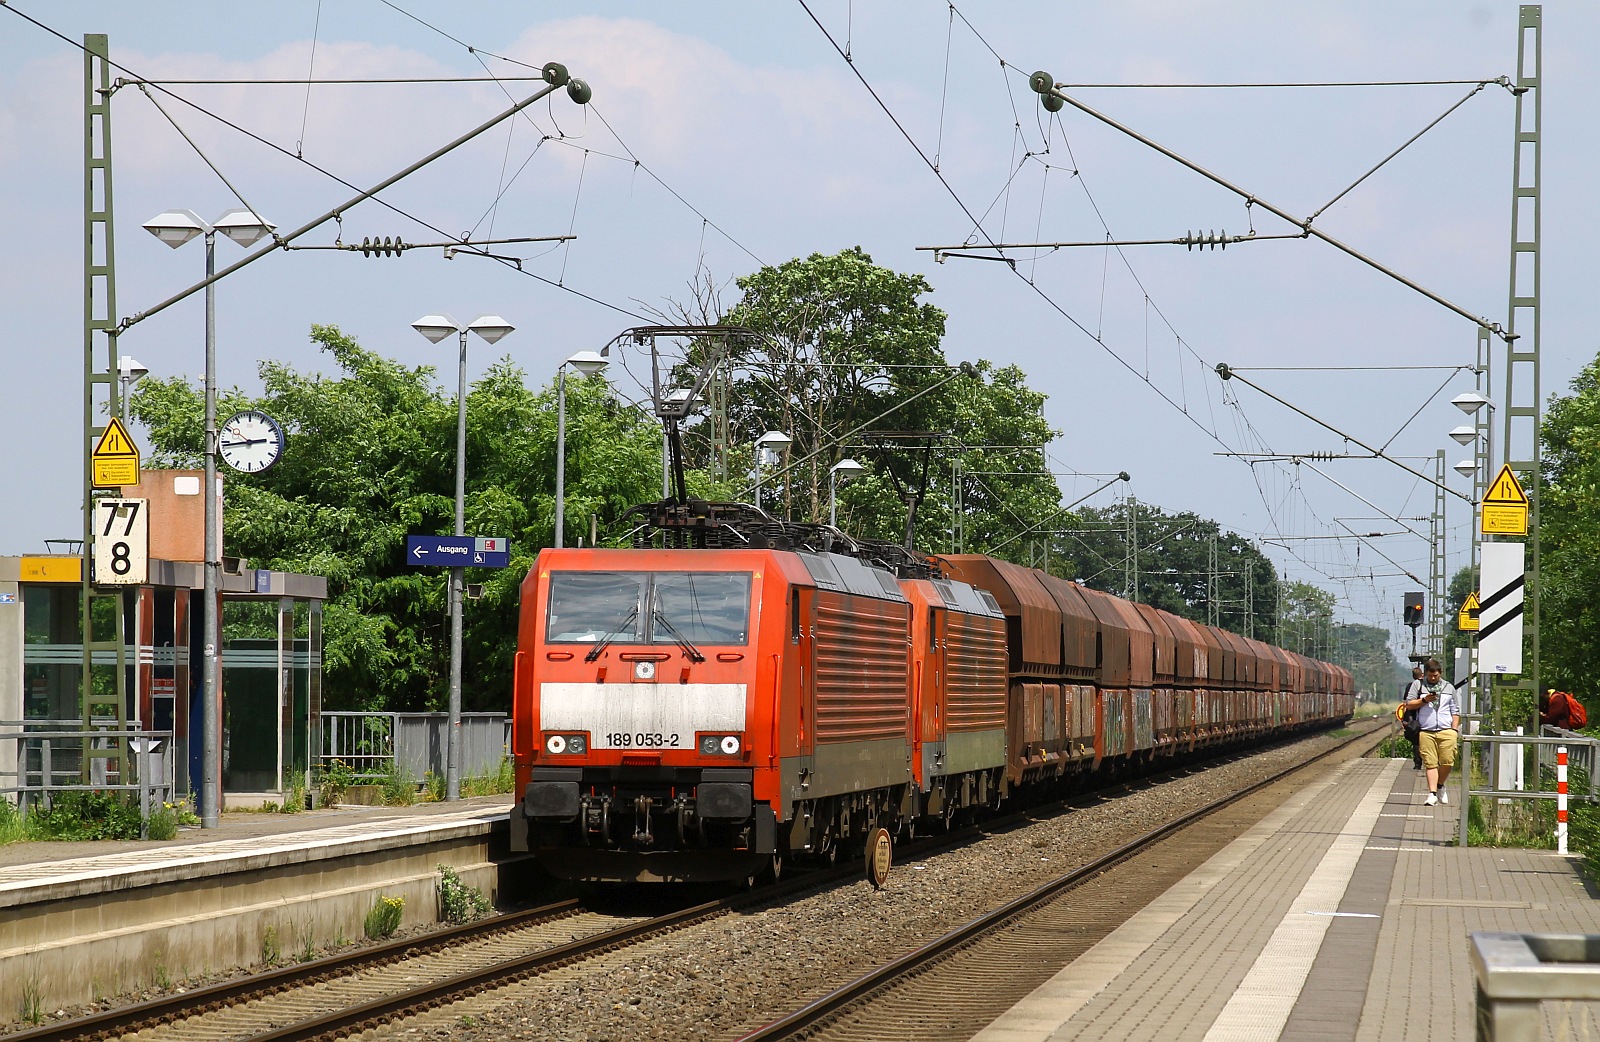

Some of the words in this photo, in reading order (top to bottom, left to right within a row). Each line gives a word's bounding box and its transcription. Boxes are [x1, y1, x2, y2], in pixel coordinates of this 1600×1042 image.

[101, 503, 140, 537] 77
[111, 541, 131, 575] 8
[436, 544, 468, 554] Ausgang
[606, 733, 632, 747] 189
[635, 733, 679, 747] 053-2
